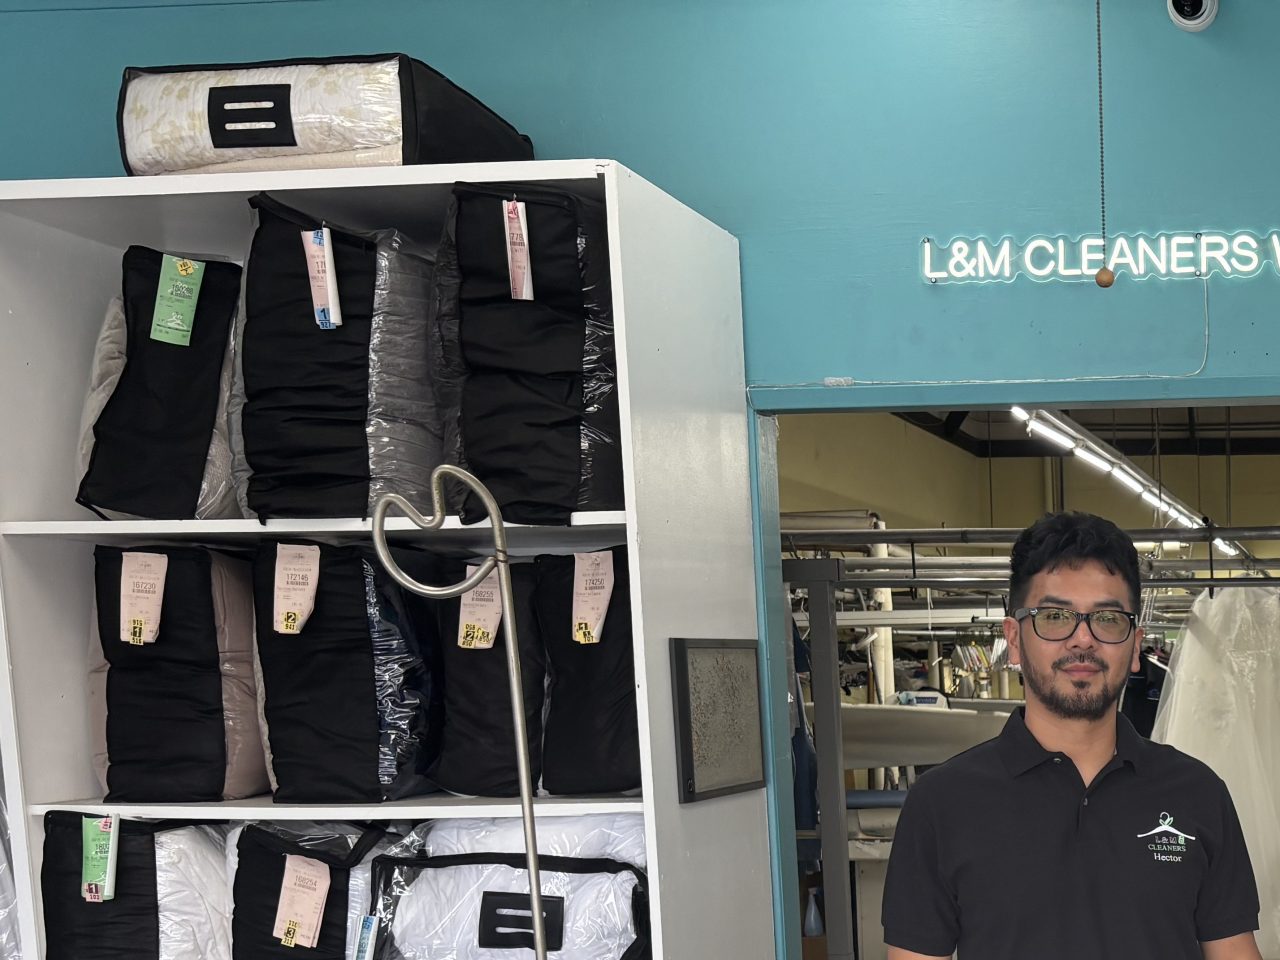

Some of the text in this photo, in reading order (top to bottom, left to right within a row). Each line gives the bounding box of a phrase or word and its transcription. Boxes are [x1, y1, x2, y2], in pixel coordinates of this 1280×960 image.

[923, 239, 1011, 278] L&M
[1024, 235, 1259, 276] CLEANERS
[1148, 844, 1187, 852] CLEANERS
[1153, 852, 1183, 862] Hector
